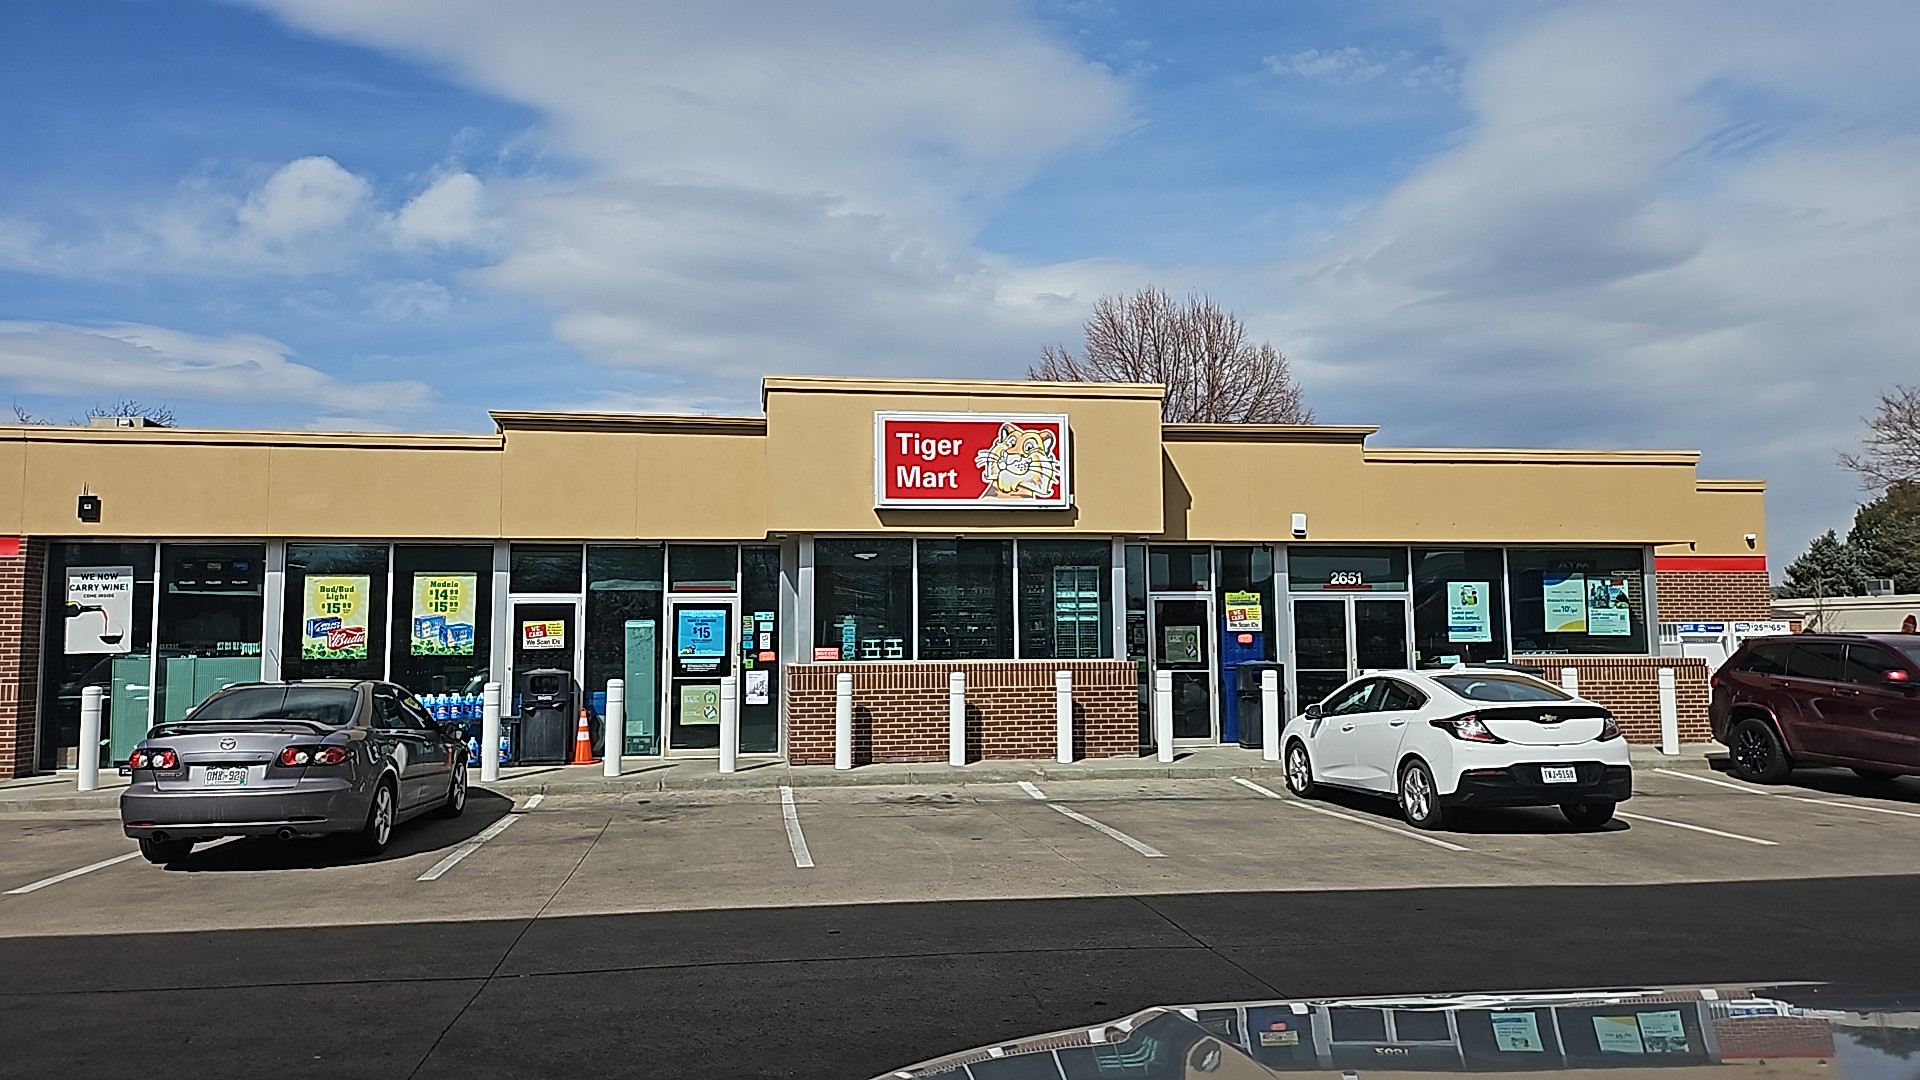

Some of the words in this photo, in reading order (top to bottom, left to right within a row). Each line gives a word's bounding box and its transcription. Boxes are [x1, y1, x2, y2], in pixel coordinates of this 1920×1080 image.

[895, 432, 963, 461] Tiger
[896, 465, 959, 489] Mart
[1557, 561, 1590, 570] ATM
[80, 573, 95, 581] WE
[97, 572, 119, 581] NOW
[1330, 571, 1362, 585] 2651
[69, 583, 100, 592] CARRY
[101, 583, 129, 591] WINE!
[429, 580, 459, 588] Modelo
[319, 585, 355, 593] Bud/Bud
[325, 593, 348, 602] Light
[692, 626, 711, 639] $15
[536, 638, 551, 646] Scan
